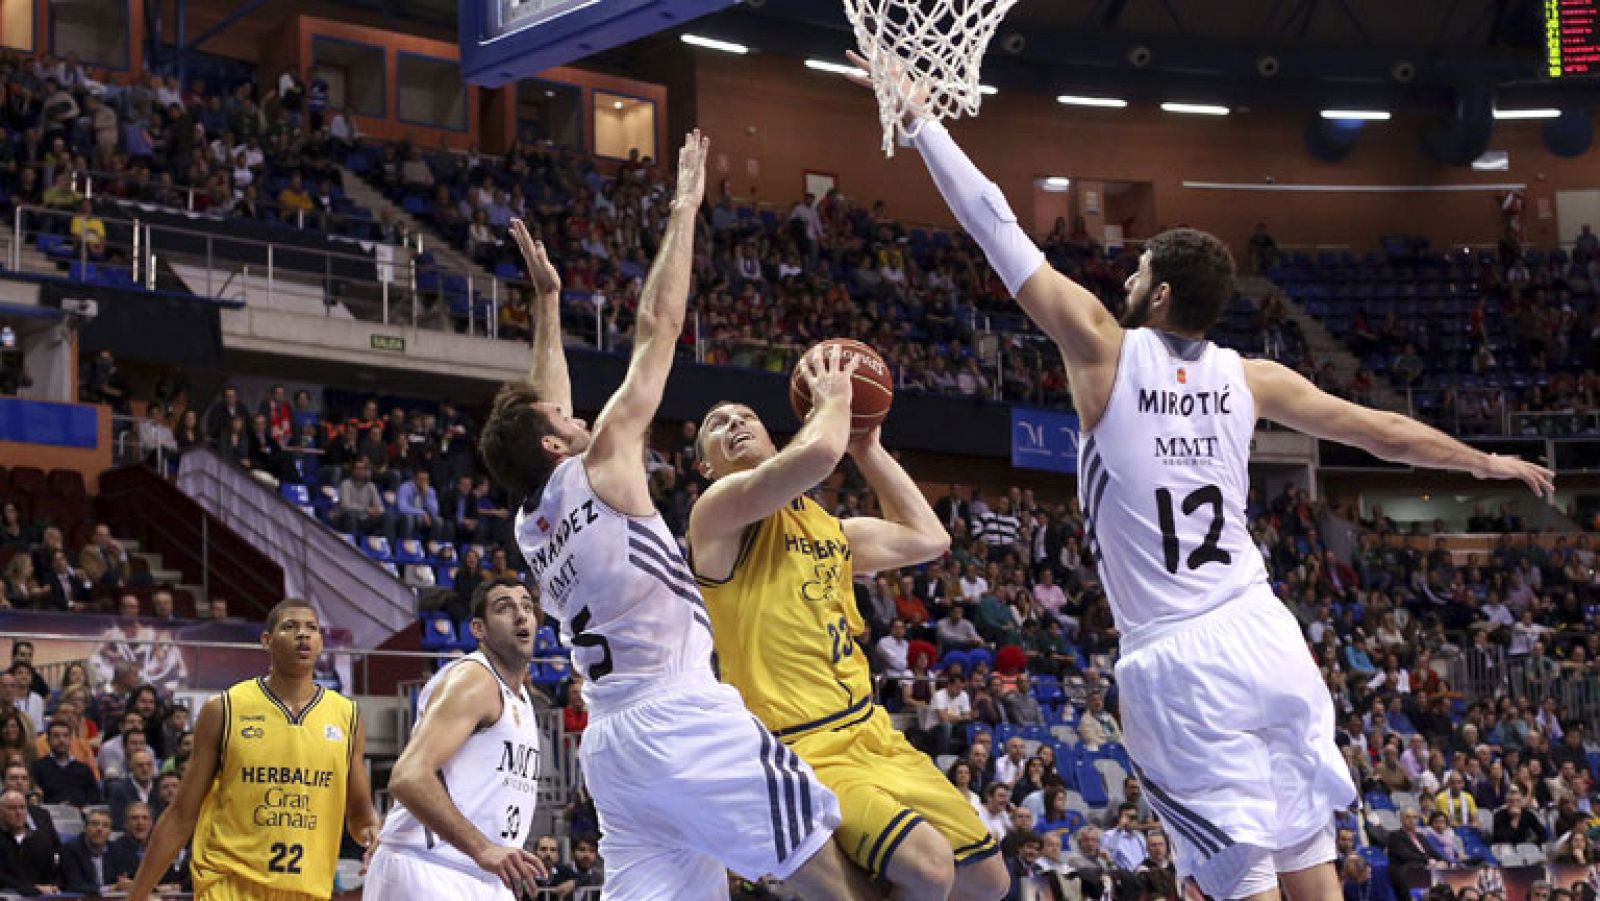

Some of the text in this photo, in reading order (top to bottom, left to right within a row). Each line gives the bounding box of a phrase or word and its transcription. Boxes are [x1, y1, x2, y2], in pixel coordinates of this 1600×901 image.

[1138, 384, 1231, 417] MIROTIĆ
[1154, 436, 1218, 457] MMT
[1155, 485, 1231, 574] 12
[570, 604, 613, 682] 5
[828, 616, 853, 663] 23
[241, 766, 334, 788] HERBALIFE
[264, 786, 310, 811] Gran
[268, 842, 304, 874] 22
